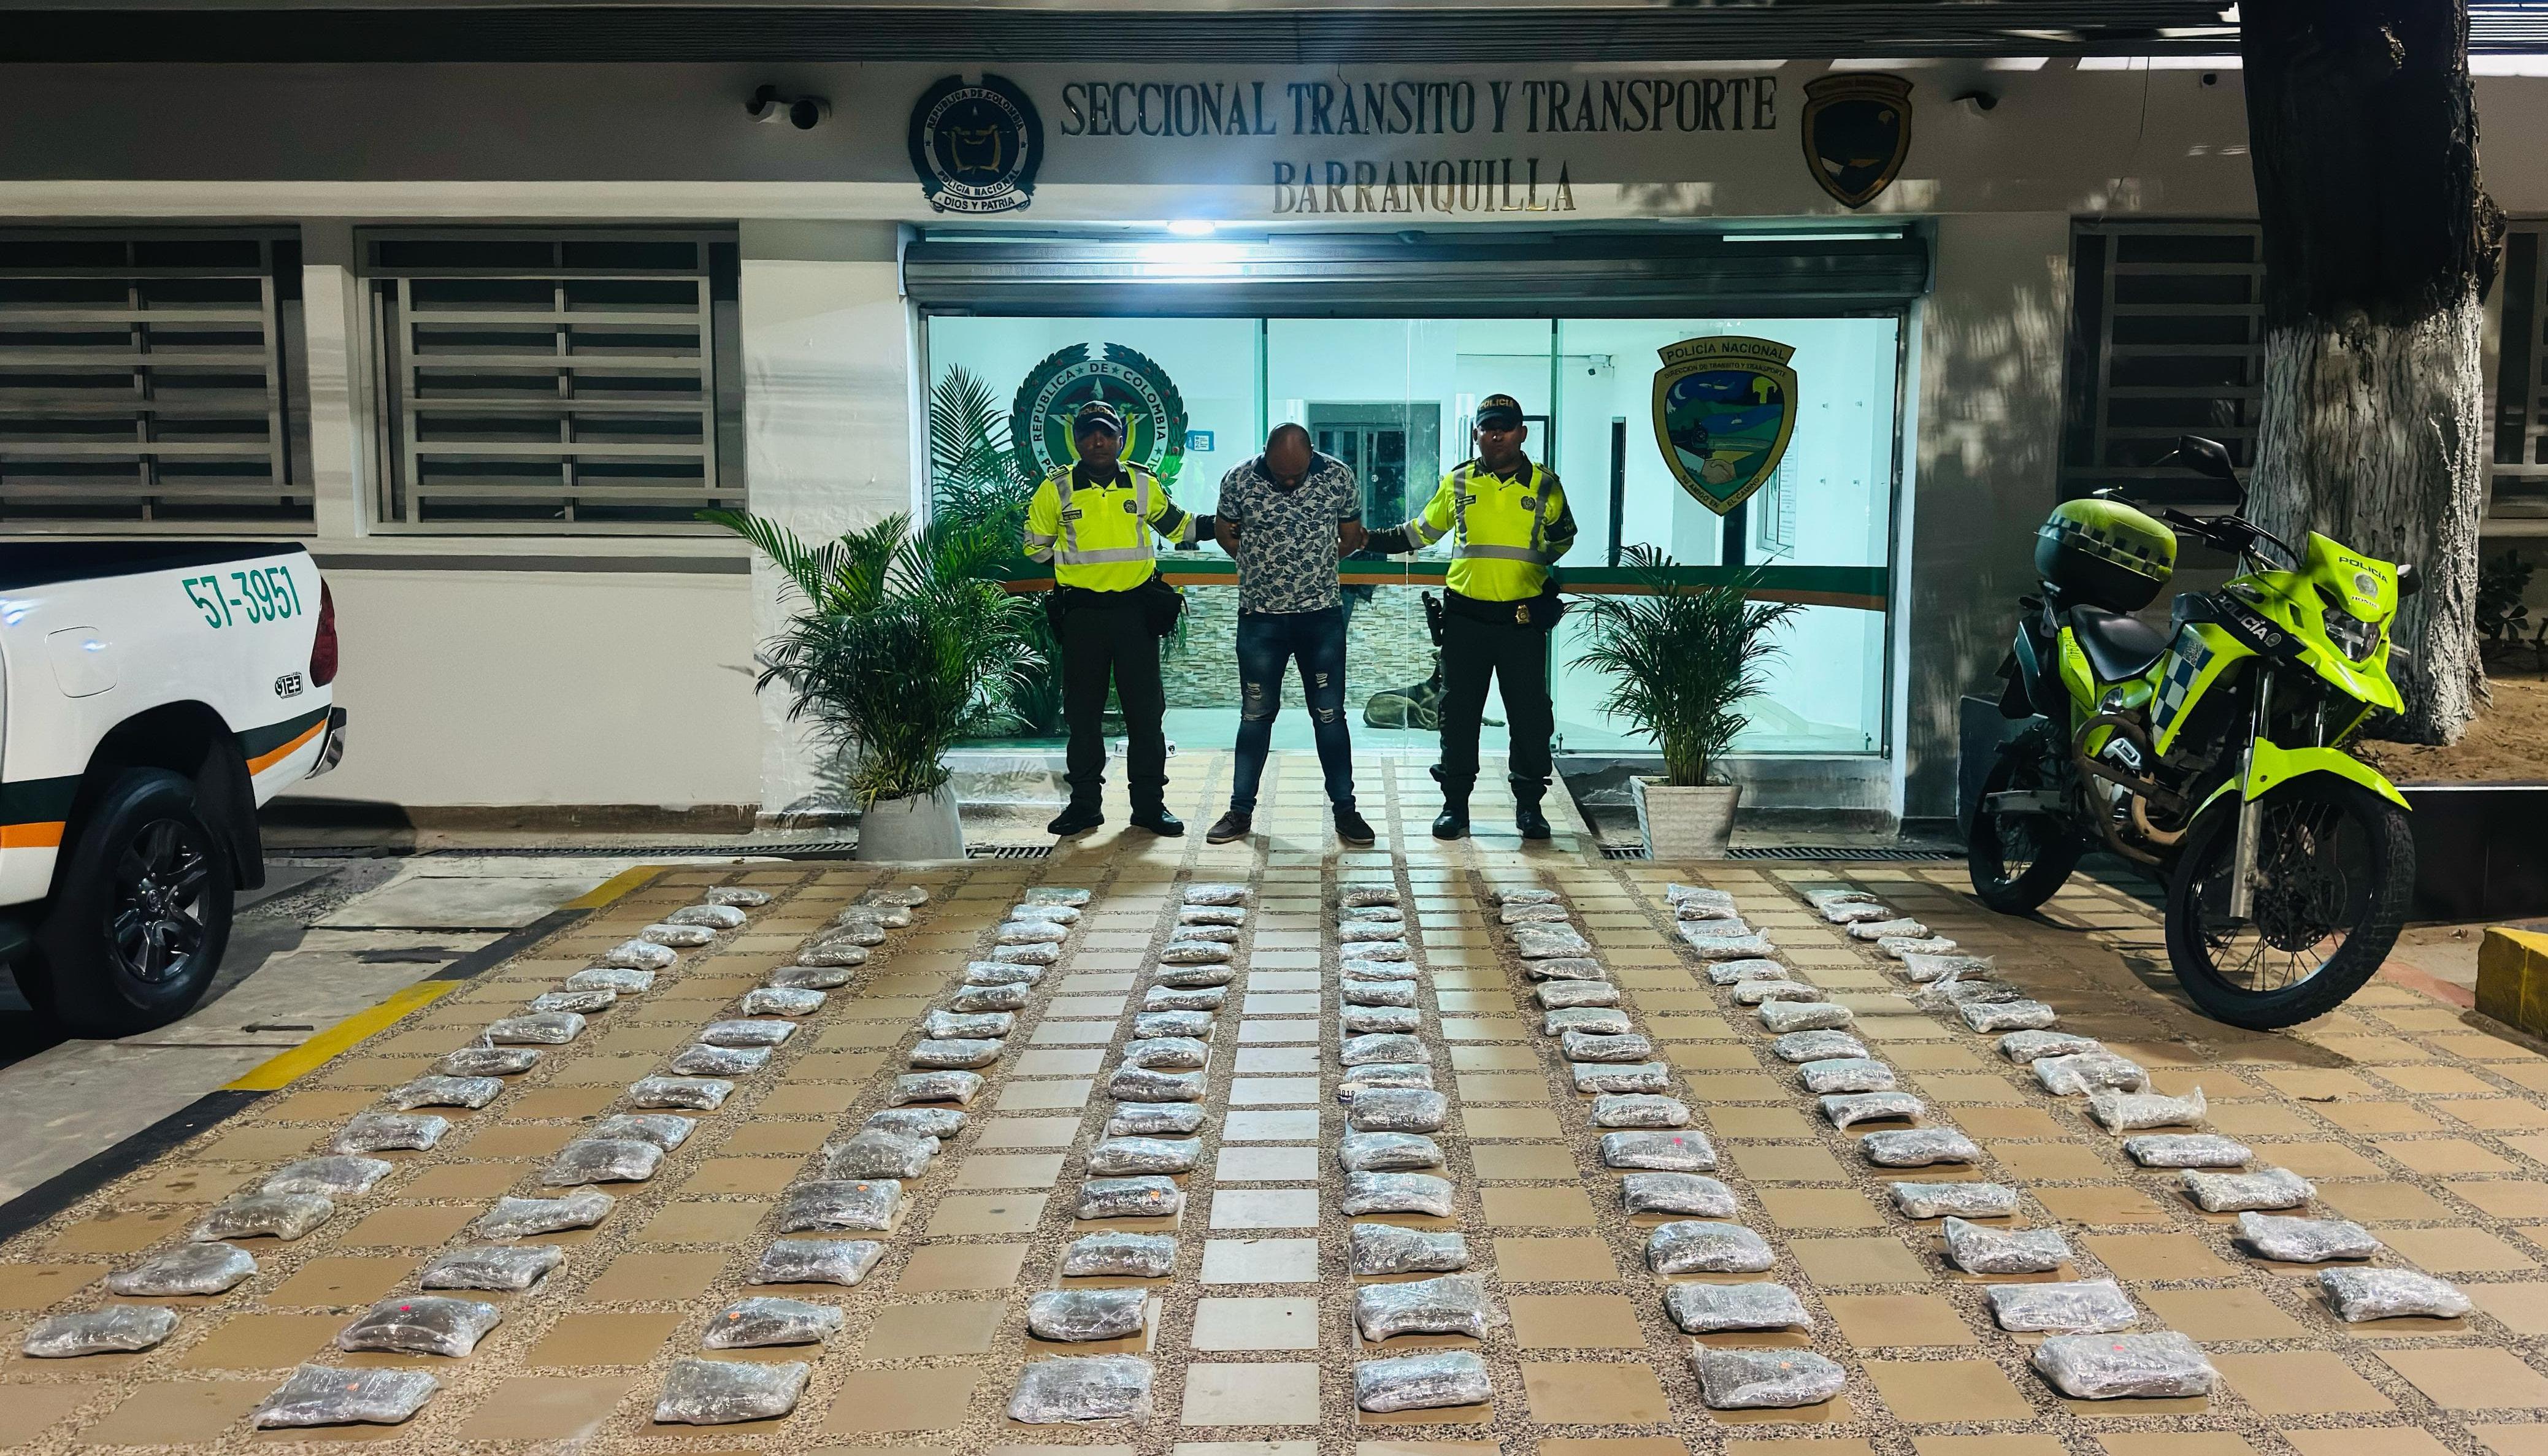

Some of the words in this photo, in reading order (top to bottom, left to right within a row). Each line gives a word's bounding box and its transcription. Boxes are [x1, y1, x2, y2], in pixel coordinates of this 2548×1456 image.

[971, 89, 983, 98] DE
[984, 91, 1024, 131] COLOMBIA
[1061, 82, 1276, 136] SECCIONAL
[1288, 82, 1475, 135] TRANSITO
[1488, 80, 1512, 132] Y
[1522, 76, 1777, 132] TRANSPORTE
[937, 171, 970, 195] POLICIA
[974, 170, 1021, 196] NACIONAL
[944, 196, 969, 210] DIOS
[972, 201, 979, 210] Y
[981, 197, 1015, 210] PATRIA
[1273, 158, 1576, 215] BARRANQUILLA
[1722, 343, 1784, 359] NACIONAL
[1033, 370, 1076, 442] REPUBLICA
[1090, 363, 1108, 373] DE
[1123, 371, 1166, 441] COLOMBIA
[182, 566, 302, 629] 57-3951
